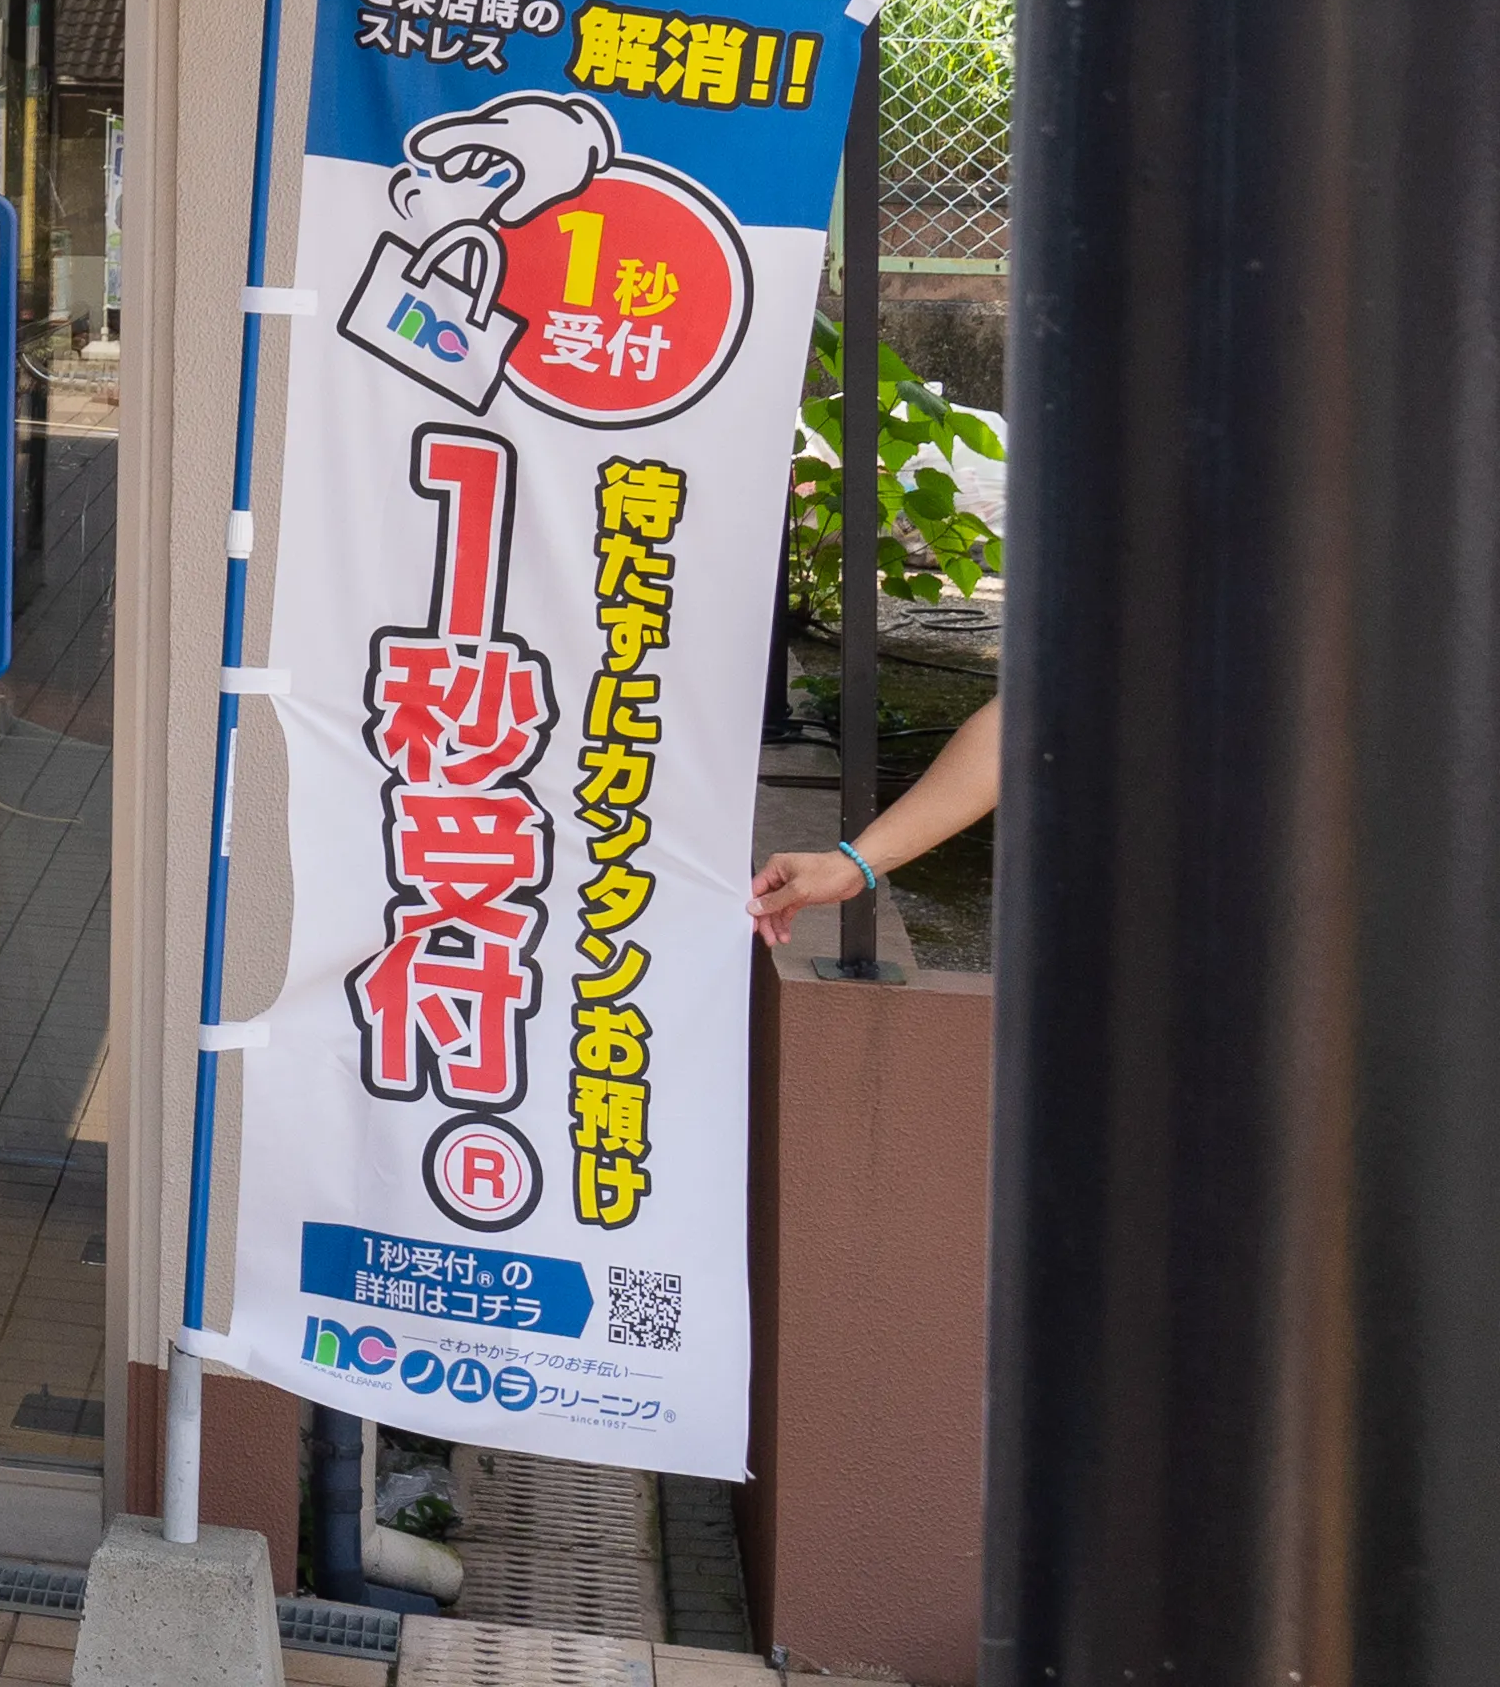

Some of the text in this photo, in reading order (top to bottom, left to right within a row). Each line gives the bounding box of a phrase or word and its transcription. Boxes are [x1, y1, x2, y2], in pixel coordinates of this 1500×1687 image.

[359, 14, 507, 69] ストレス
[571, 5, 817, 105] 解消!!
[557, 210, 680, 317] 1秒
[540, 311, 671, 381] 受付
[370, 440, 541, 1096] 1秒受付
[574, 460, 681, 1226] 待たずにカンタンお預け
[354, 1270, 542, 1327] 詳細はコチラ
[345, 1375, 393, 1391] CLEANING
[439, 1337, 629, 1379] さわやかライフのお手伝い
